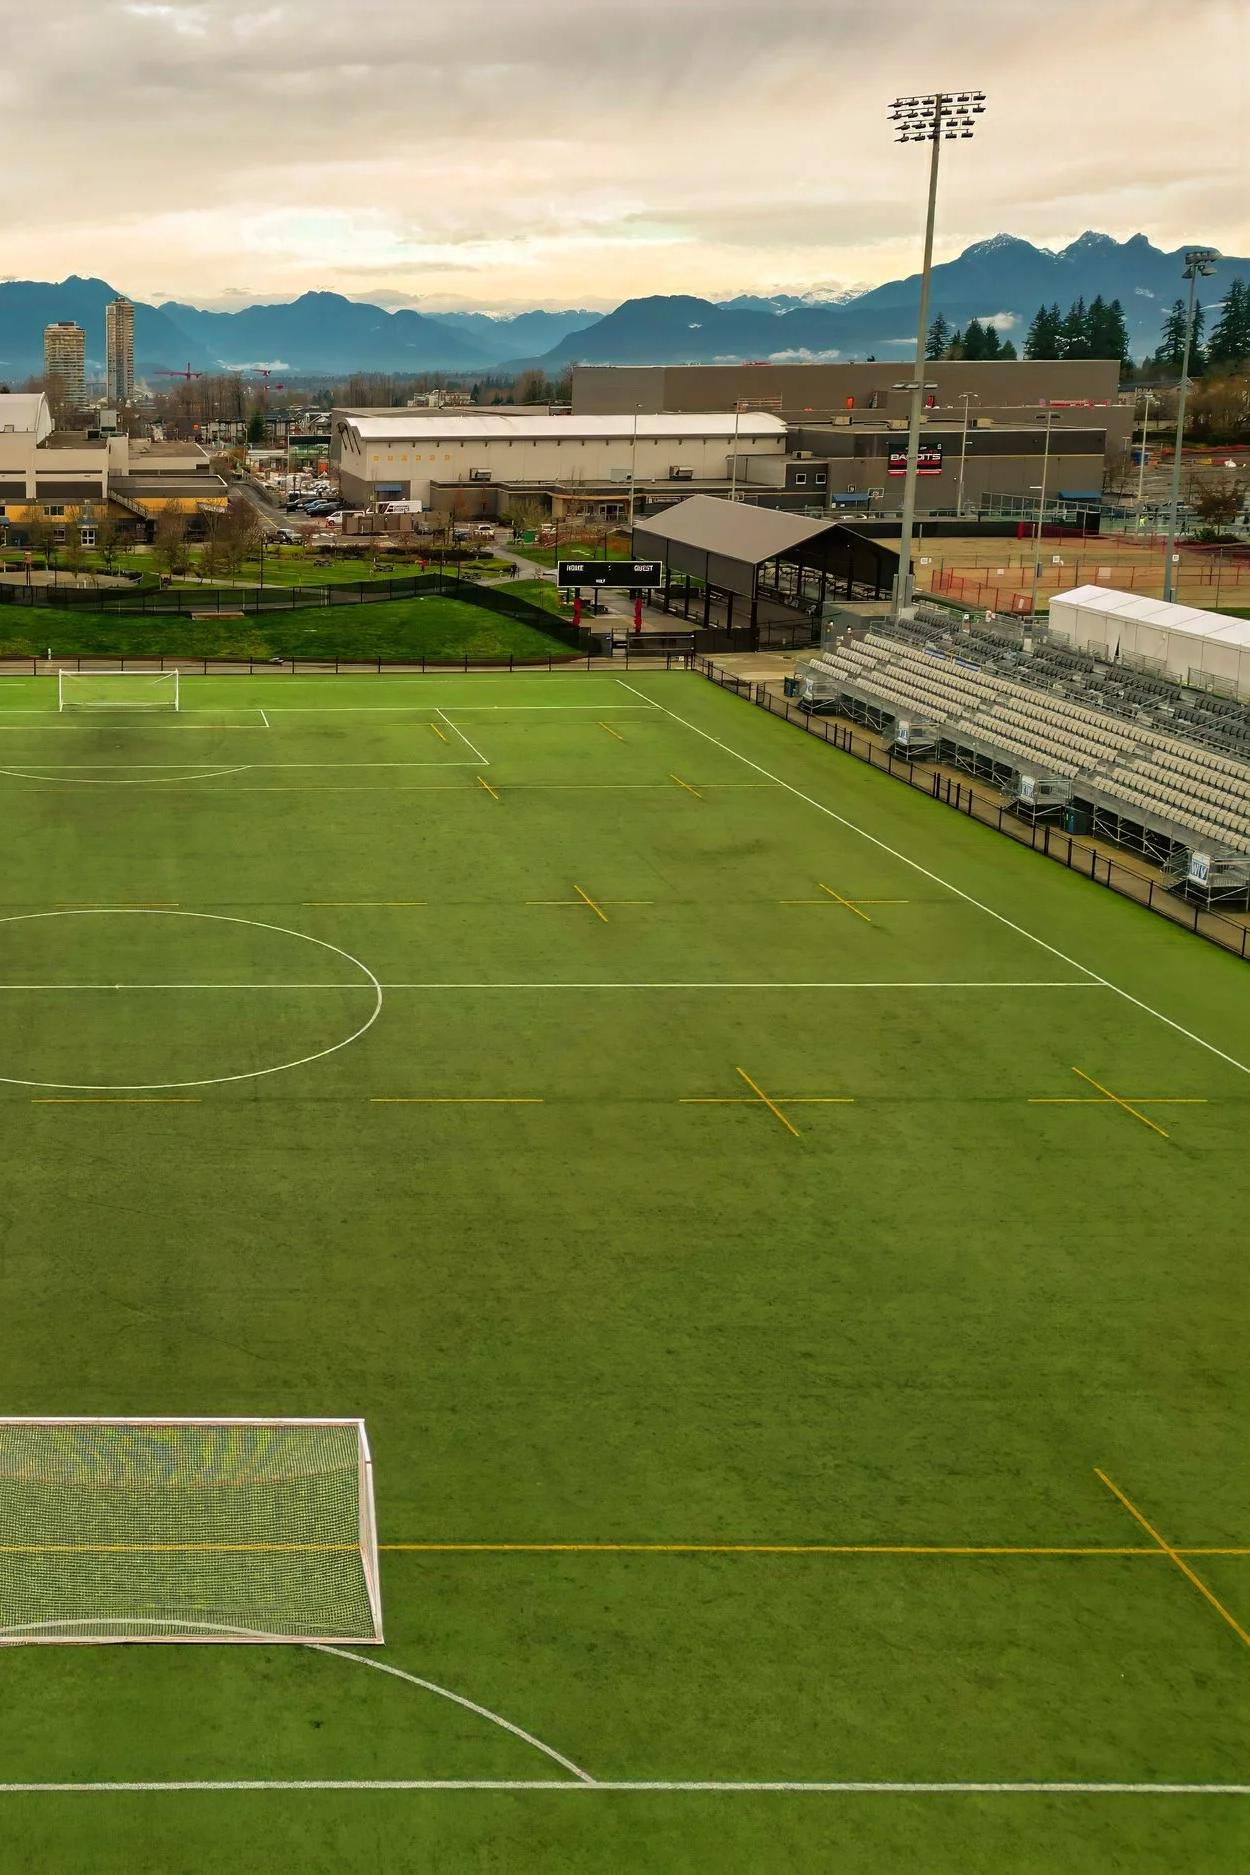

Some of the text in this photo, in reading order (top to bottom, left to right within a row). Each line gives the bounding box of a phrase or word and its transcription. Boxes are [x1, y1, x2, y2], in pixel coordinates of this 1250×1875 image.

[890, 453, 941, 461] BADITS
[566, 564, 584, 572] HOME
[633, 564, 654, 572] GUEST
